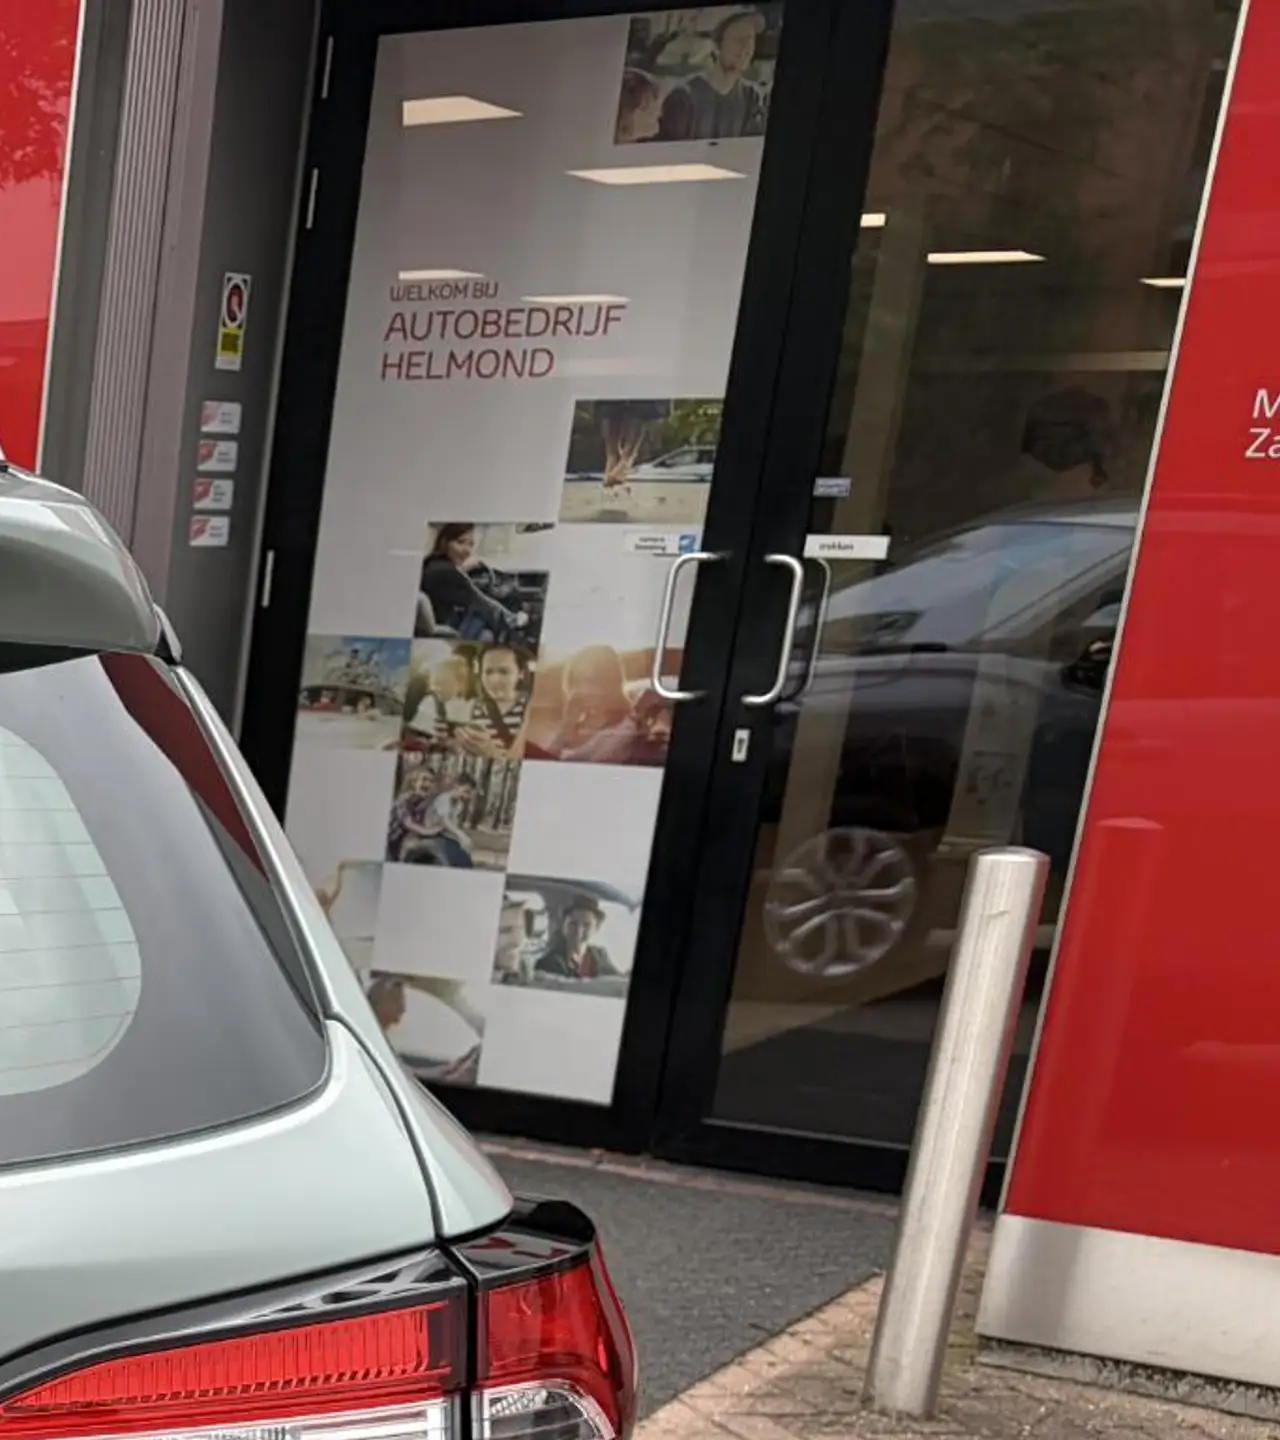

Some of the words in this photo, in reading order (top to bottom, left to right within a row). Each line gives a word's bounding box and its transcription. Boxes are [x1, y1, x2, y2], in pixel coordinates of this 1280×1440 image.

[390, 282, 469, 301] WELKOM
[383, 304, 628, 342] AUTOBEDRIJF
[380, 348, 555, 381] HELMOND
